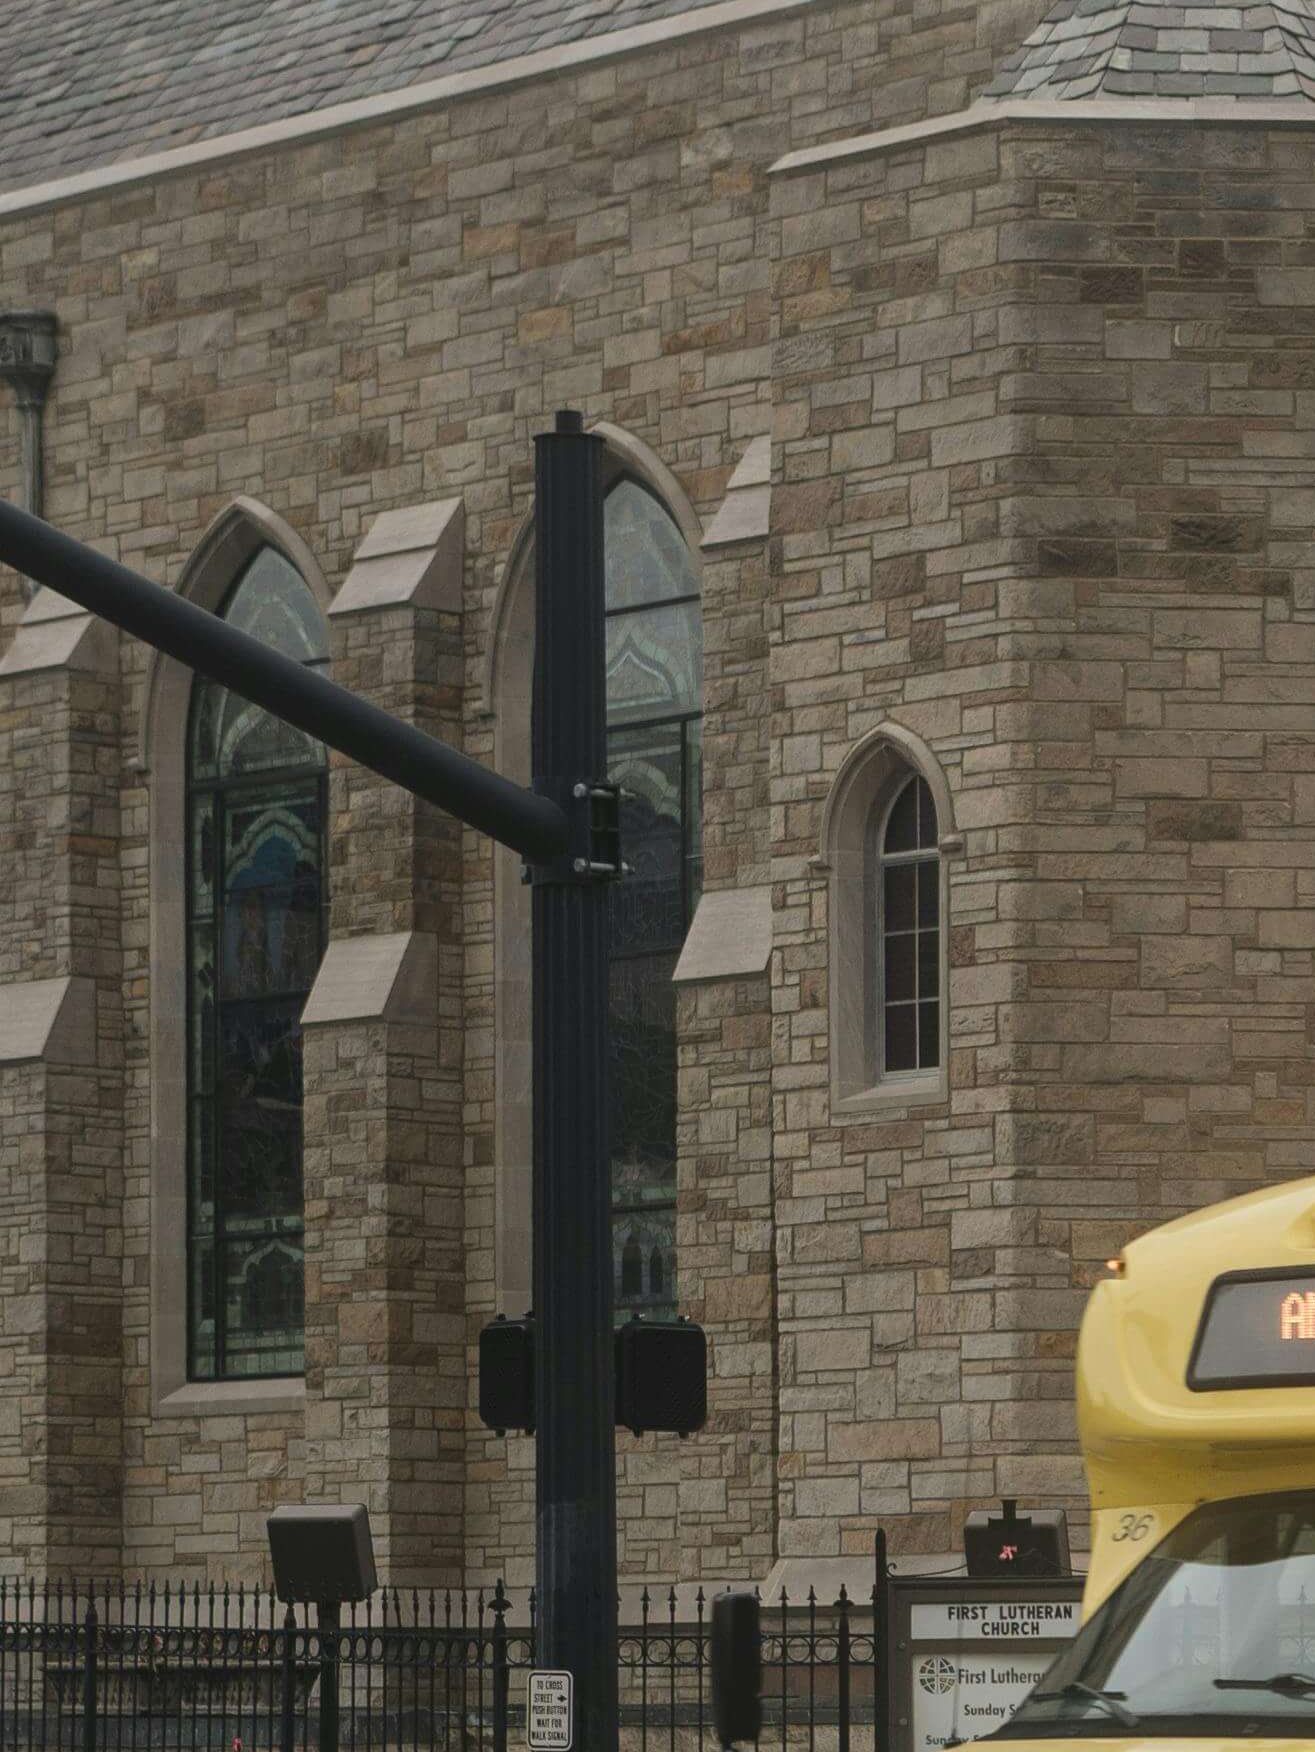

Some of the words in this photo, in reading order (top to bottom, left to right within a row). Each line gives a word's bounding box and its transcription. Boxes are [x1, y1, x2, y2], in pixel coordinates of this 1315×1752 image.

[1111, 1513, 1154, 1542] 36
[948, 1606, 988, 1621] FIRST
[999, 1605, 1073, 1620] LUTHERAN
[981, 1622, 1040, 1636] CHURCH
[958, 1668, 986, 1684] First
[536, 1680, 544, 1690] TO
[546, 1680, 563, 1690] CROSS
[534, 1694, 553, 1703] STREET
[532, 1705, 545, 1715] PUSH
[546, 1705, 567, 1715] BUTTON
[964, 1703, 1006, 1719] Sunday
[536, 1718, 550, 1728] WAIT
[551, 1718, 562, 1728] FOR
[531, 1731, 546, 1741] WALK
[548, 1731, 567, 1741] SIGNAL
[926, 1734, 969, 1746] Sun
